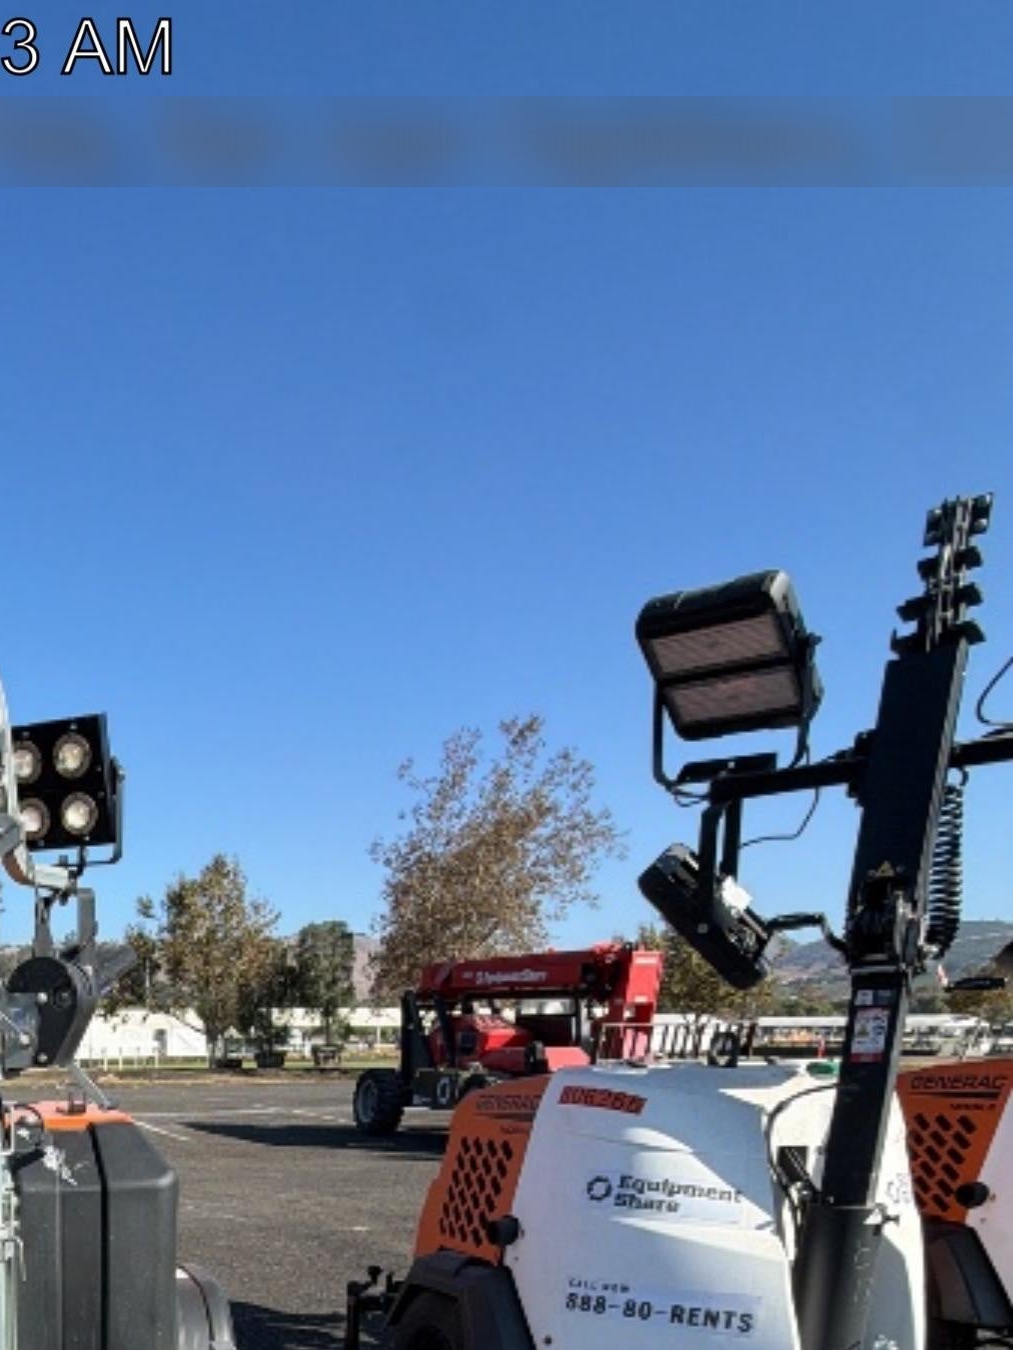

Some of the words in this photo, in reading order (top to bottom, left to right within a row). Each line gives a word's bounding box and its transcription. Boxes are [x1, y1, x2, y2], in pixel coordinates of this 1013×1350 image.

[910, 1072, 1008, 1090] GENERAC
[617, 1175, 745, 1203] Equipment
[613, 1193, 681, 1213] Share
[565, 1291, 754, 1333] 888-80-RENTS
